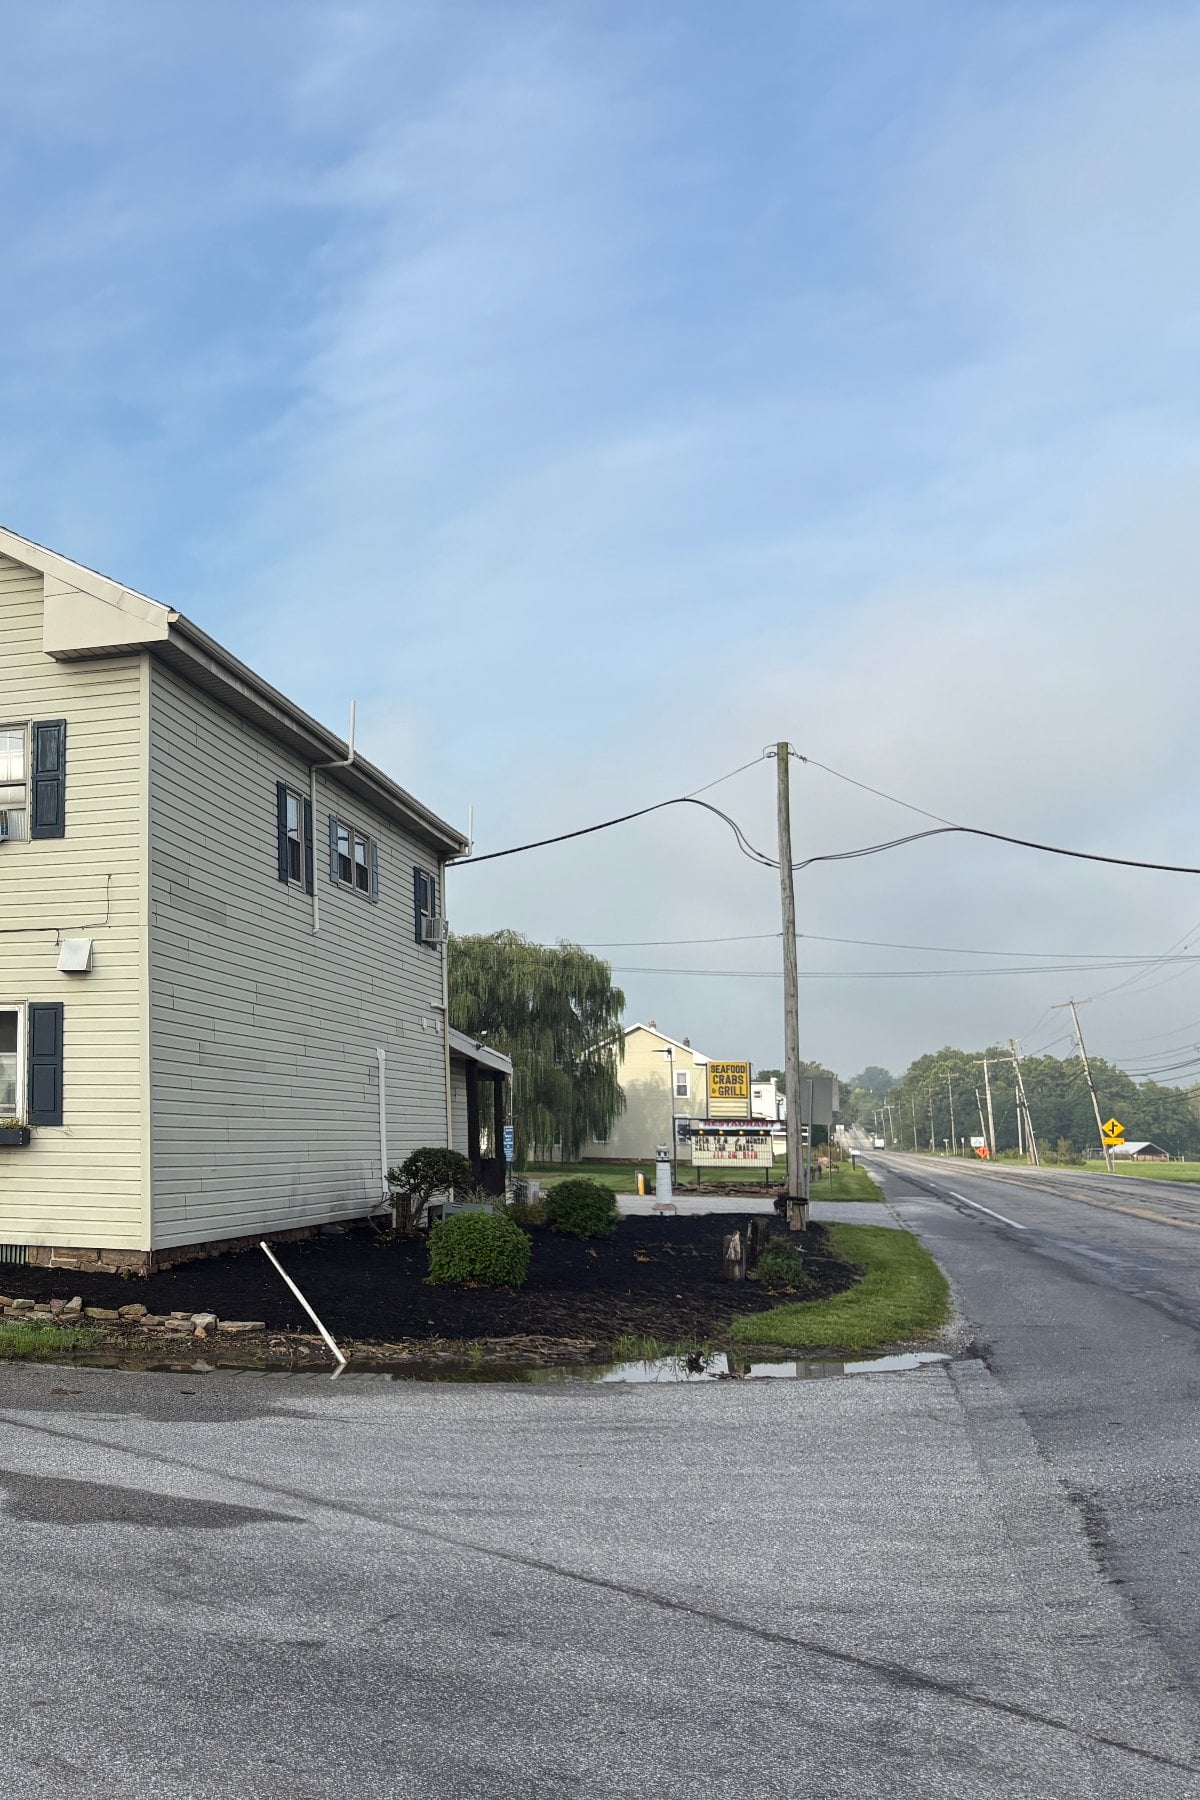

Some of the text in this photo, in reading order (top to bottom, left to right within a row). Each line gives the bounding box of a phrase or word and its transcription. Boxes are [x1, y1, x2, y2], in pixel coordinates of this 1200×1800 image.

[711, 1065, 745, 1073] SEAFOOD
[713, 1075, 743, 1084] CRABS
[718, 1086, 745, 1096] GRILL
